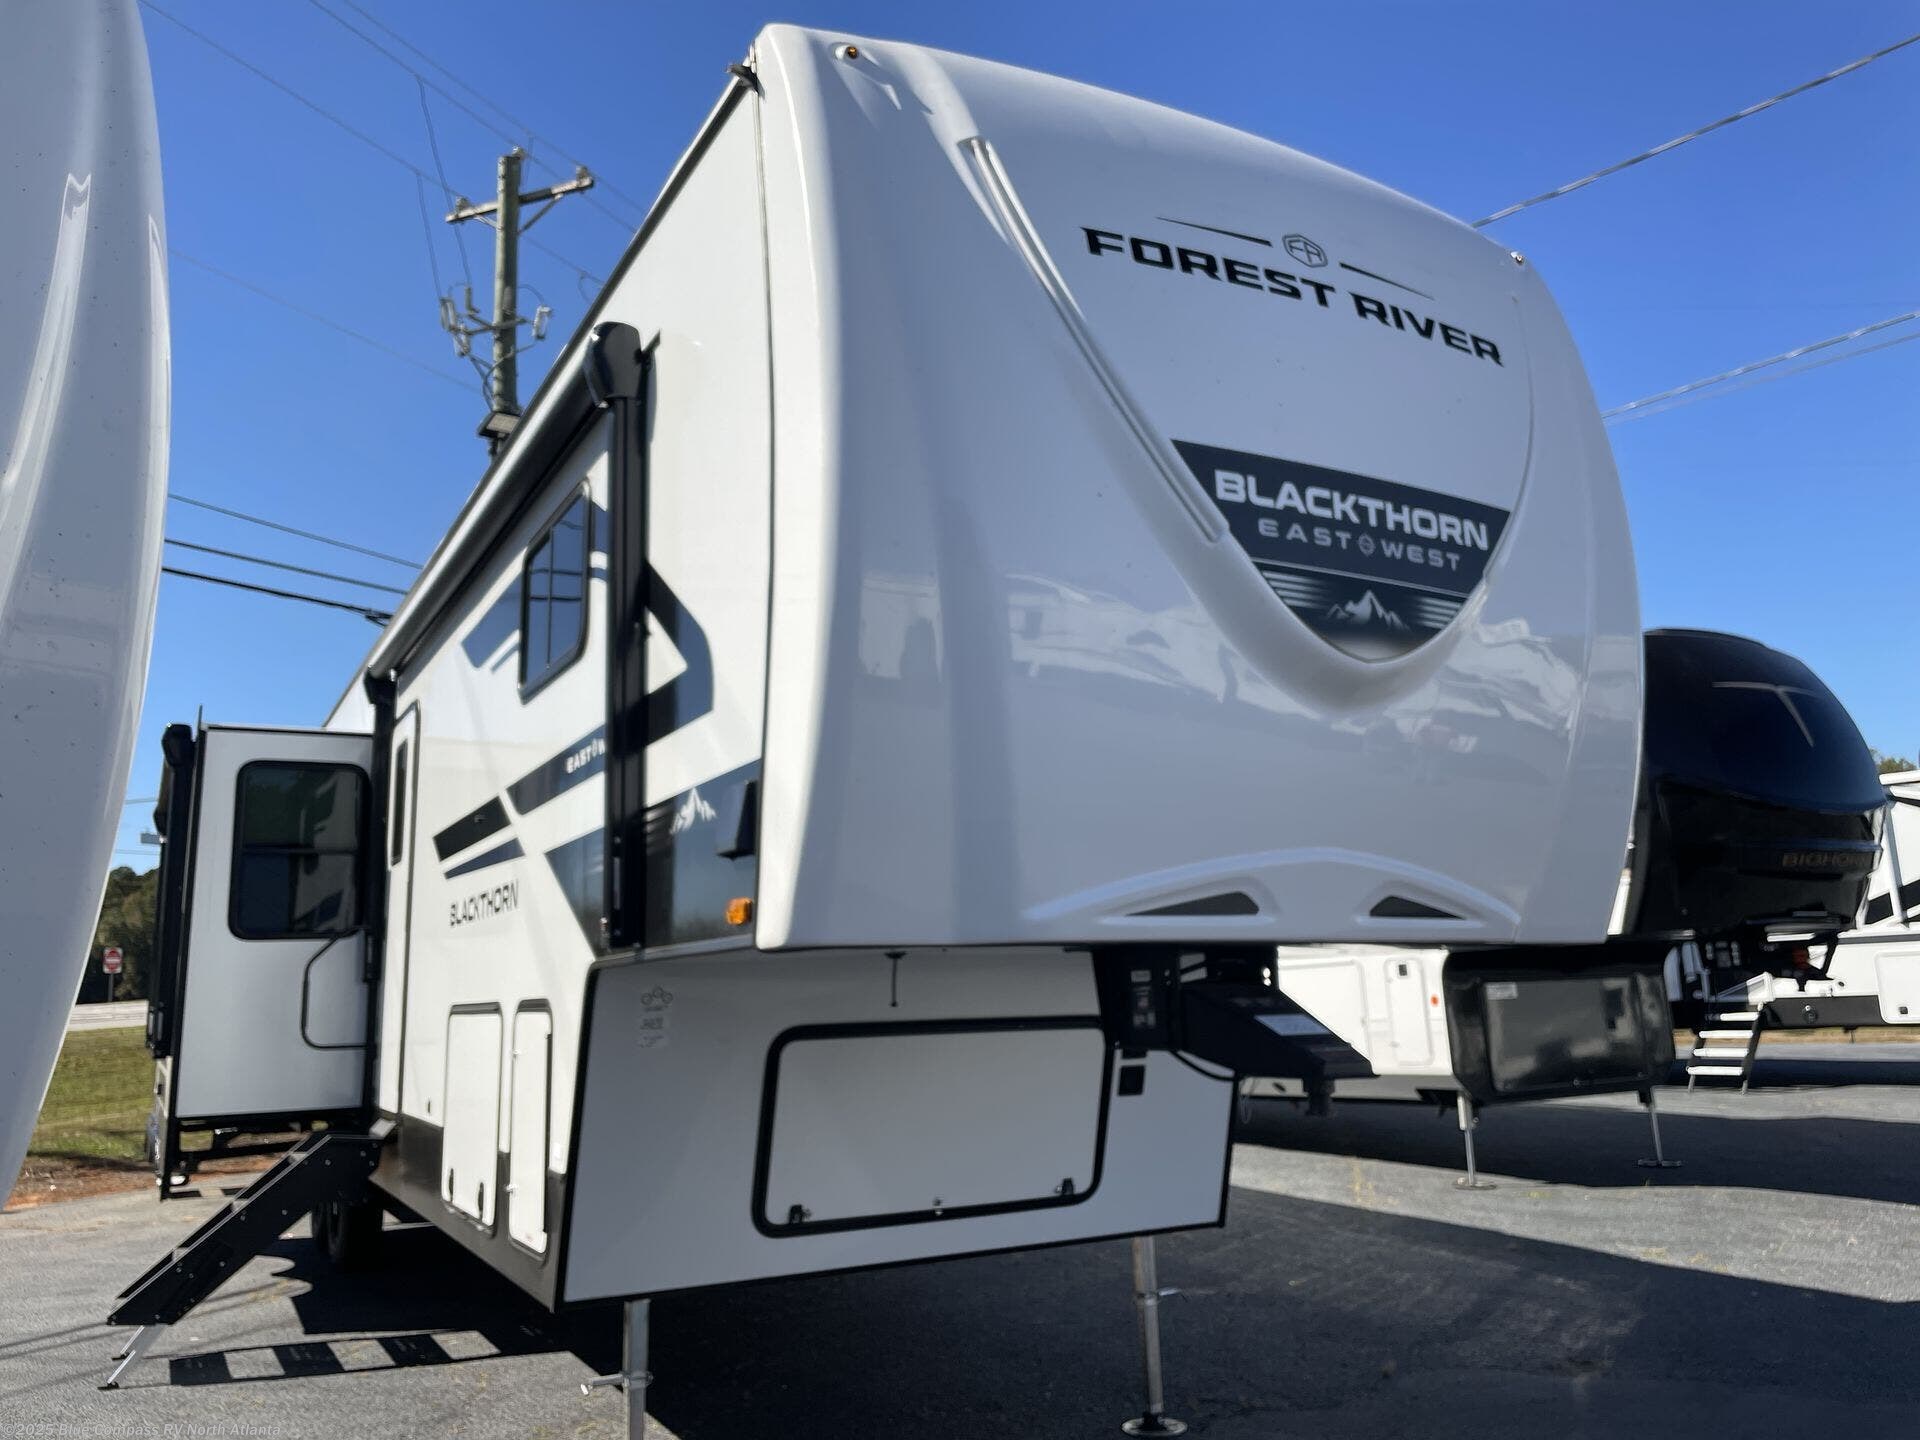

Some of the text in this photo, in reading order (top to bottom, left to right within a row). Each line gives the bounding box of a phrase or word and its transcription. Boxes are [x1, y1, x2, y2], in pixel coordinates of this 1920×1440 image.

[1080, 226, 1505, 367] FOREST RIVER
[1213, 468, 1489, 552] BLACKTHORN
[1257, 519, 1463, 571] EAST WEST
[450, 878, 519, 927] BLACKTHORN
